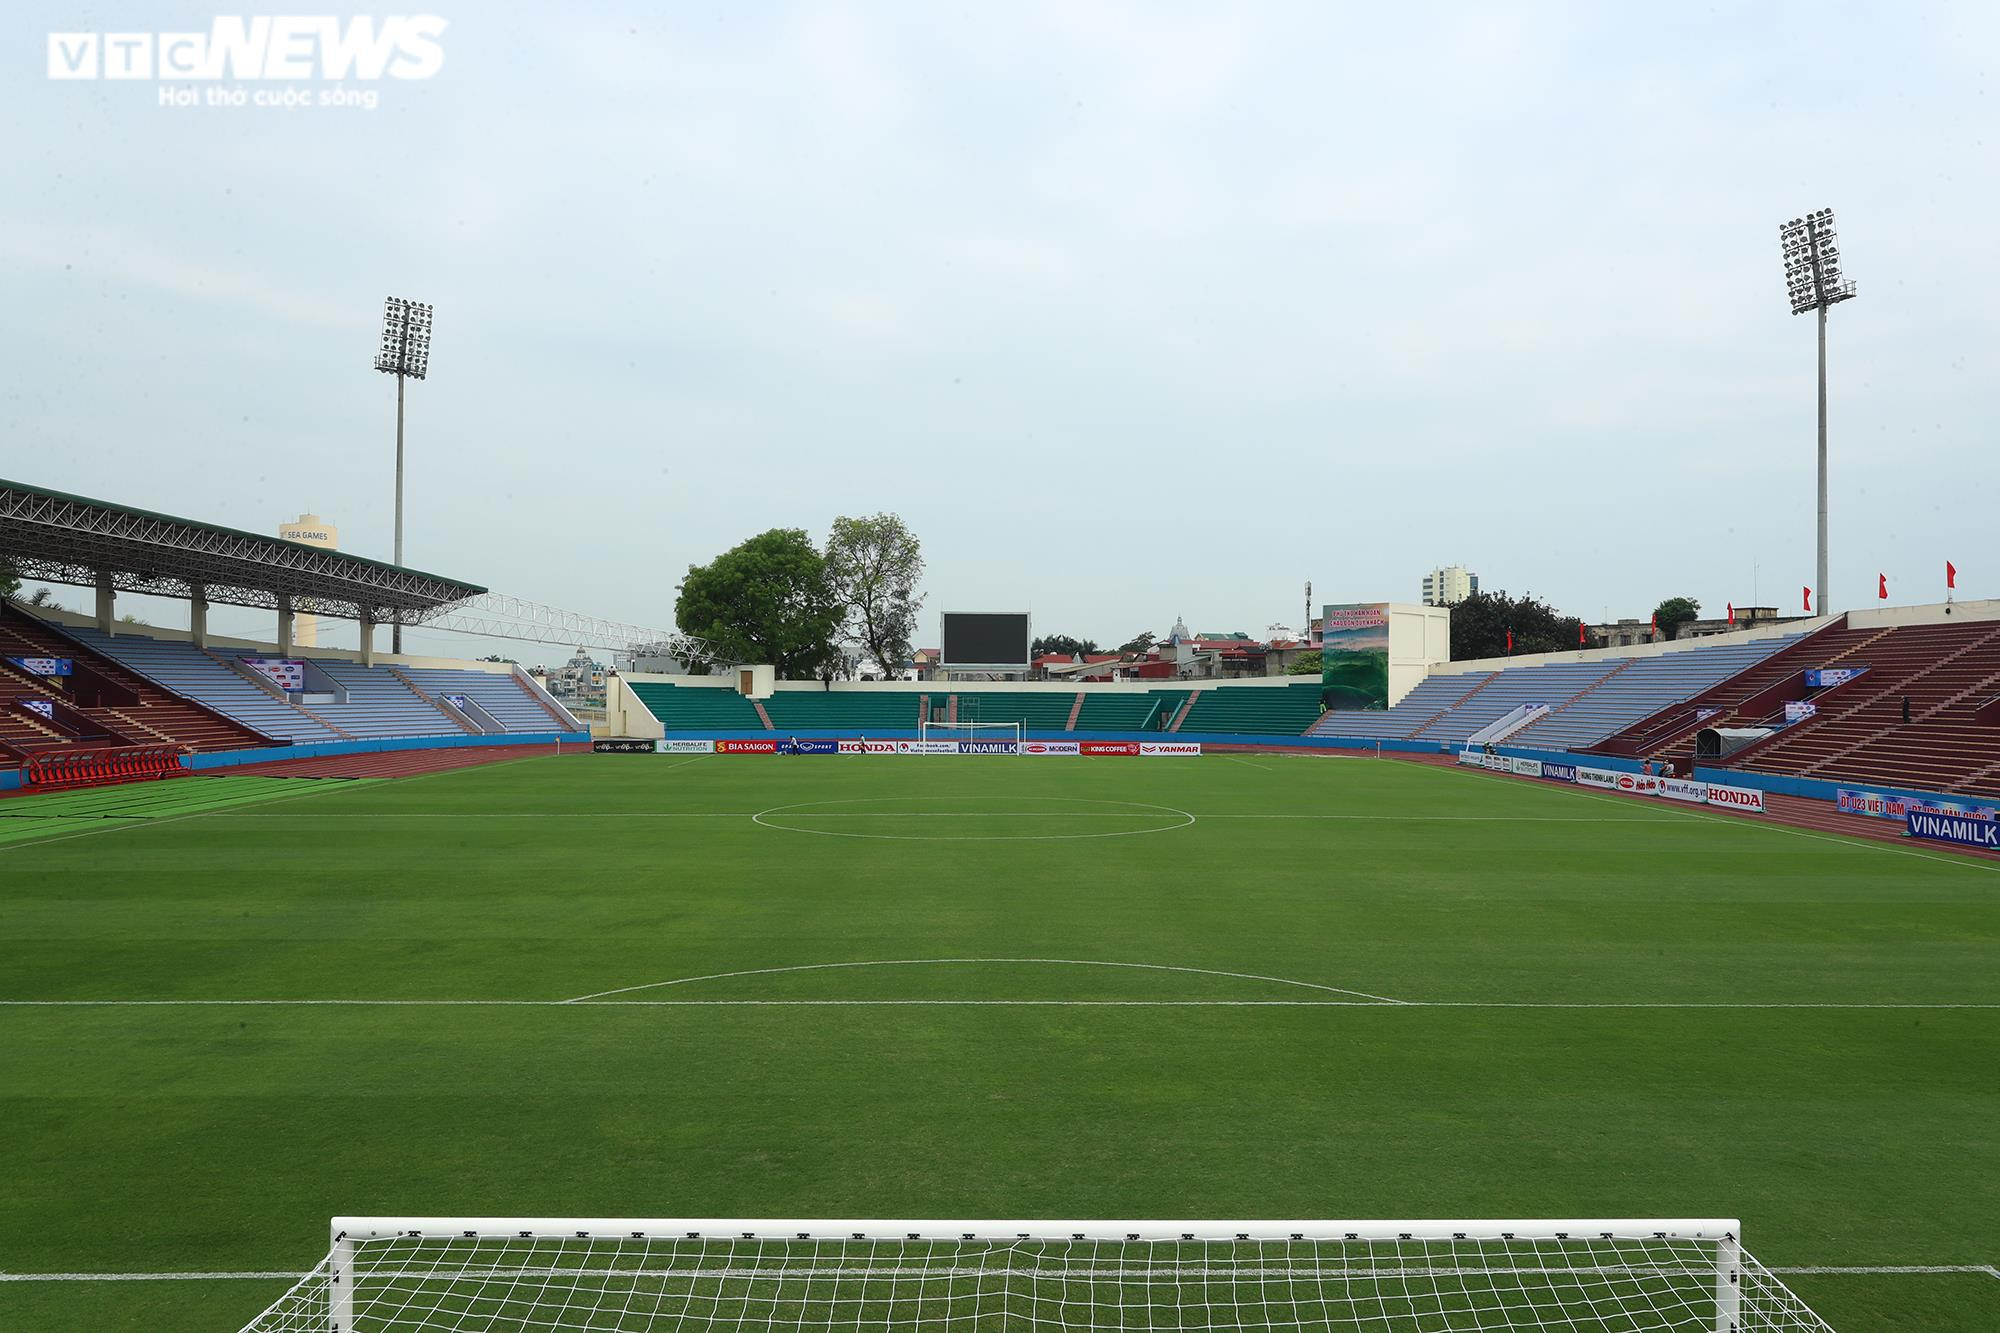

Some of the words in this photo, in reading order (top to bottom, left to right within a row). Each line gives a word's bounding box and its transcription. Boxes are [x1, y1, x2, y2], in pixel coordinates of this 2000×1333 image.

[303, 532, 328, 540] GAMES
[729, 743, 743, 751] BIA
[744, 743, 774, 751] SAIGON
[961, 744, 1017, 753] VINAMILK
[1543, 764, 1575, 780] VINAMILK
[1708, 788, 1762, 808] HONDA
[1852, 797, 1866, 811] U23
[1867, 798, 1884, 815] VIỆT
[1886, 801, 1905, 816] NAM
[1911, 815, 1998, 845] VINAMILK
